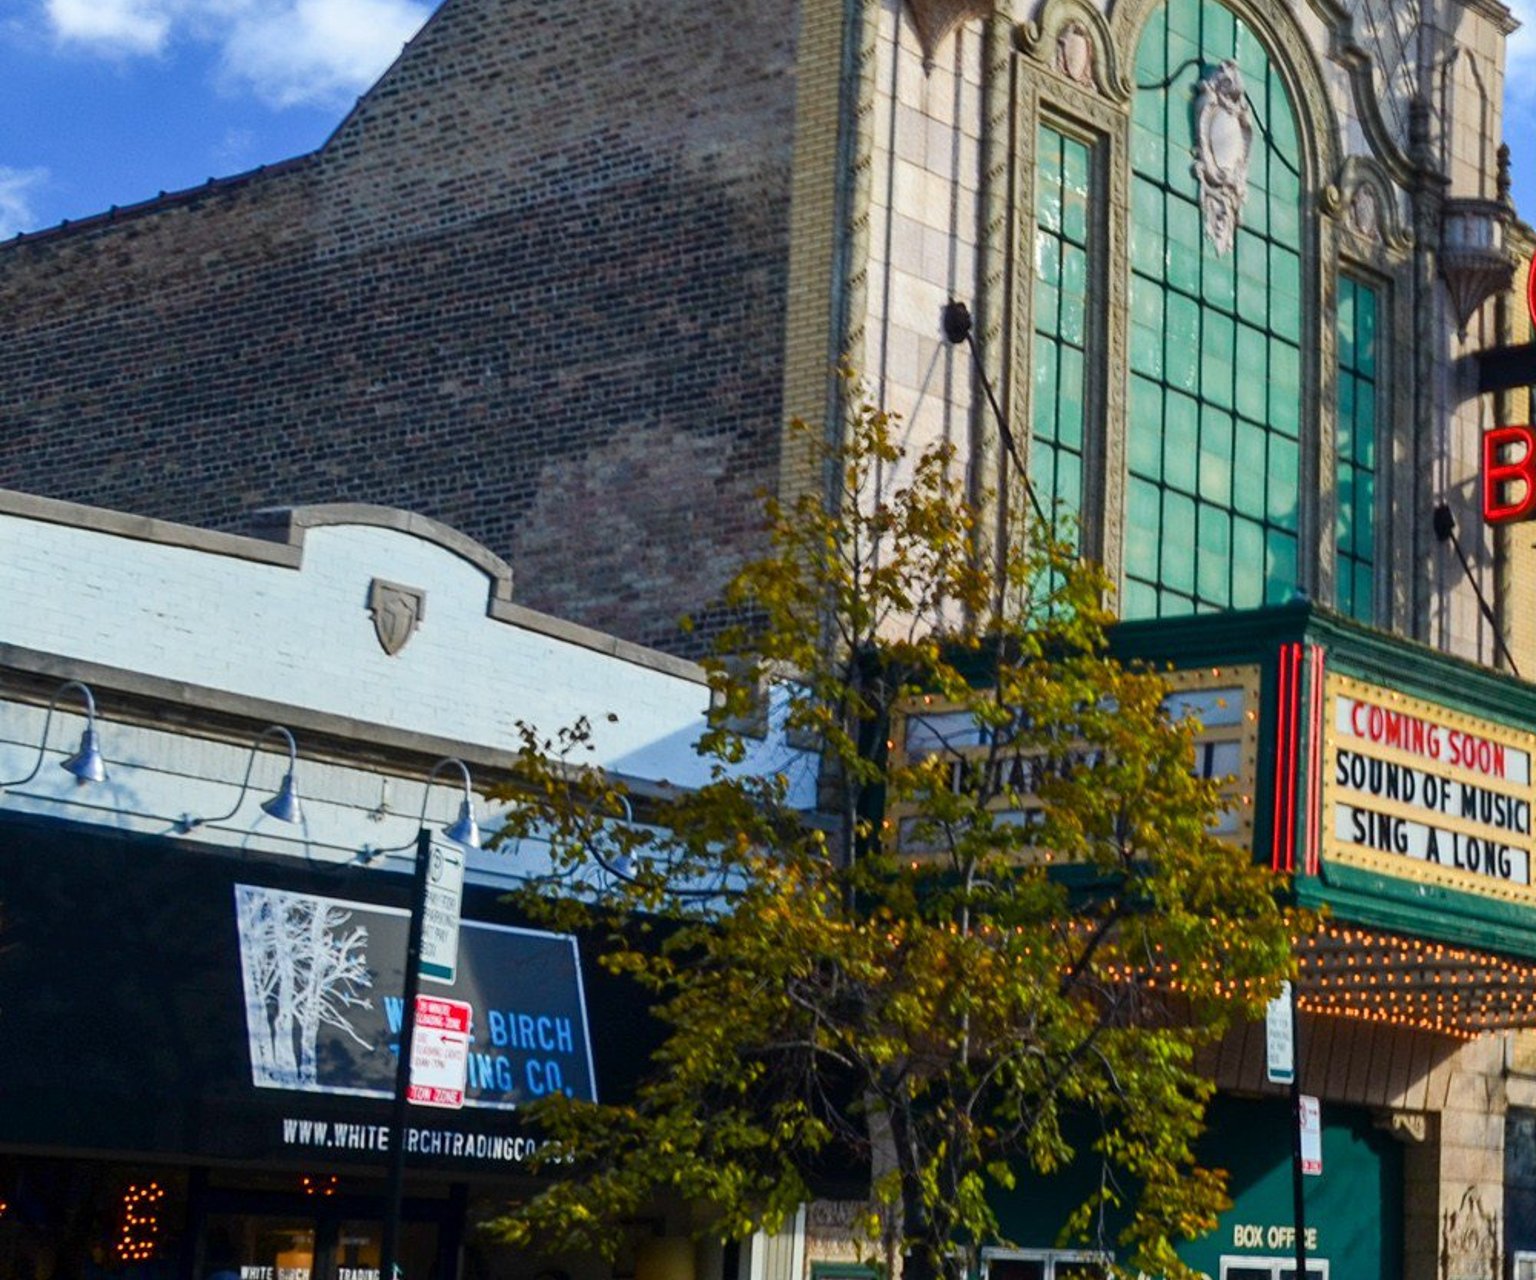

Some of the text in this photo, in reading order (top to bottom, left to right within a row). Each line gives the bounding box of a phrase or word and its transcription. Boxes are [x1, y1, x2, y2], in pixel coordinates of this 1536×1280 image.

[1352, 699, 1505, 778] COMING SOON
[1336, 749, 1526, 834] SOUND OF MUSIC
[1352, 807, 1511, 879] SING A LONG
[488, 1010, 573, 1053] BIRCH
[526, 1059, 573, 1098] CO.
[1234, 1224, 1317, 1250] BOX OFFCE
[240, 1266, 273, 1280] WHITE
